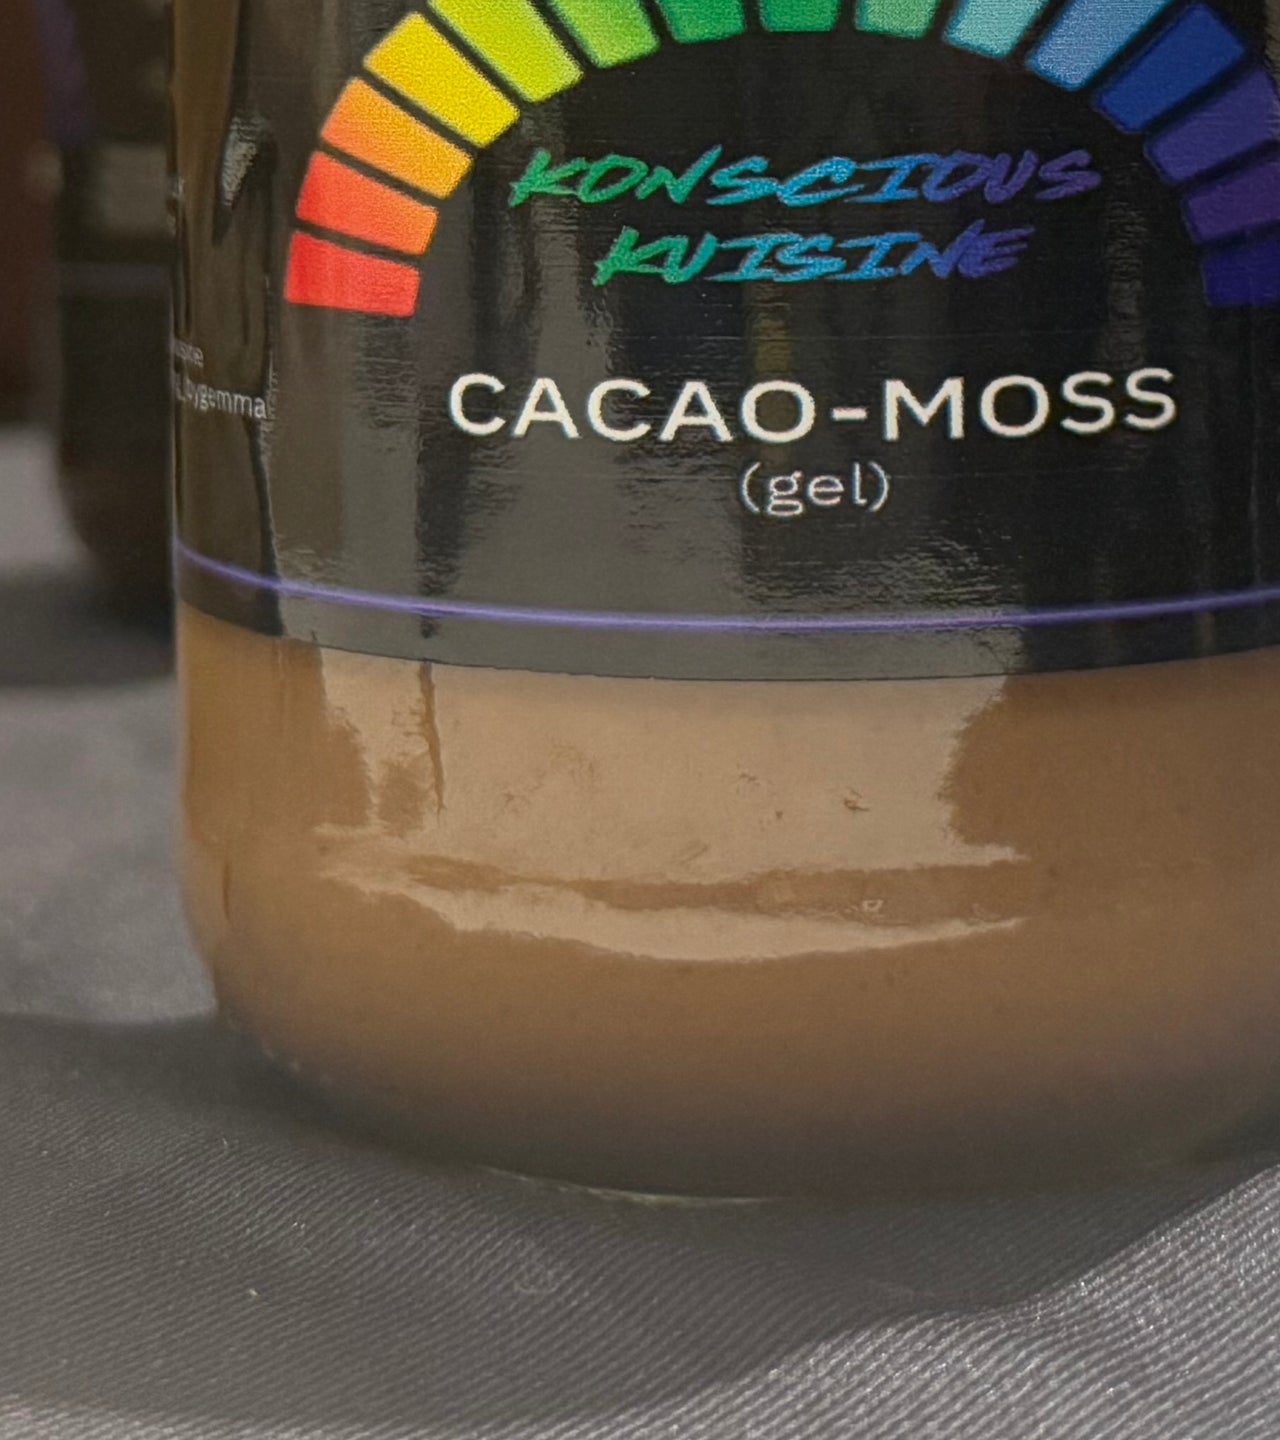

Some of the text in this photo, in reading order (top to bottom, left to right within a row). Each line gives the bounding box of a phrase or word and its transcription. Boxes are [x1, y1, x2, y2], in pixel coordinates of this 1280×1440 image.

[510, 145, 1102, 208] KONSCIOUS
[592, 218, 1035, 287] KUISINE
[448, 366, 1178, 442] CACAO-MOSS
[740, 459, 892, 519] (gel)
